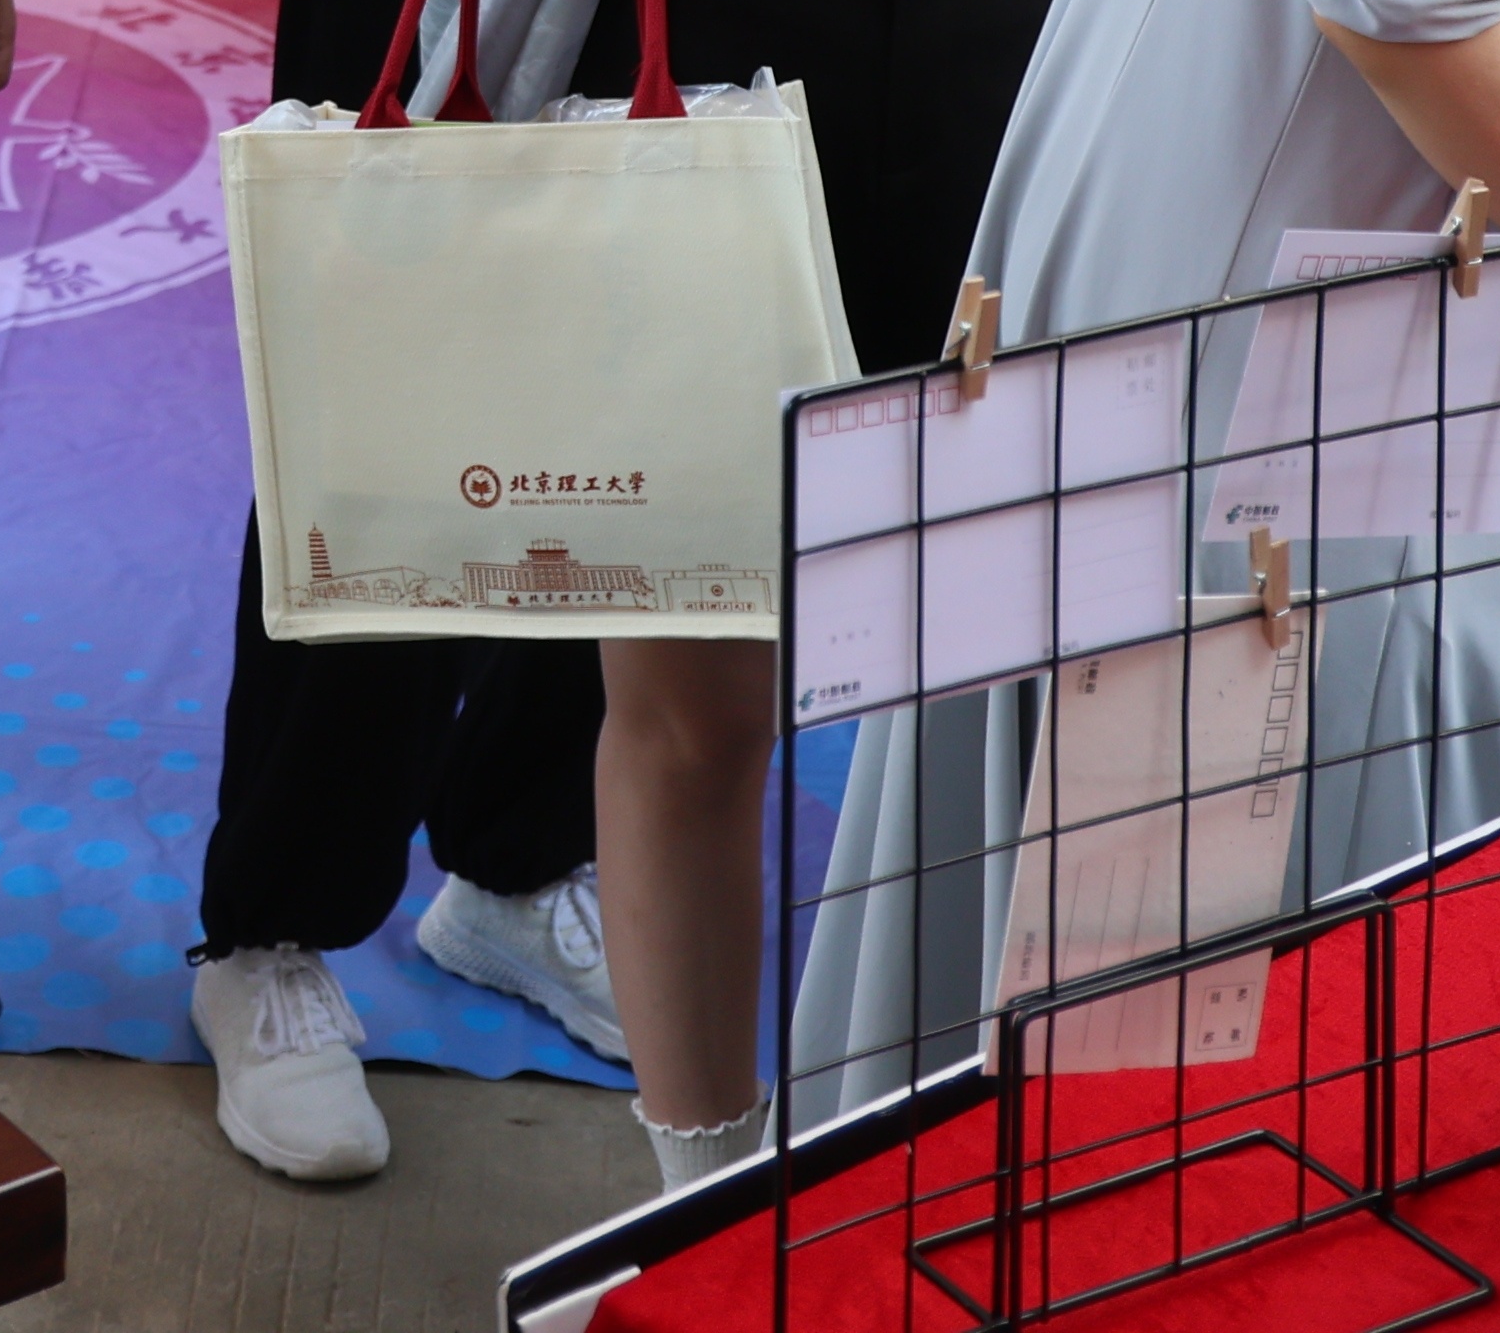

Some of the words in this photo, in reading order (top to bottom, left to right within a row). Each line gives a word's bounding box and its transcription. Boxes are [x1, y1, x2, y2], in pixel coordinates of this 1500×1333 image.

[510, 498, 541, 506] BEIJING
[542, 498, 581, 506] INSTITUTE
[584, 498, 595, 506] OF
[597, 498, 648, 506] TECHNOLOGY
